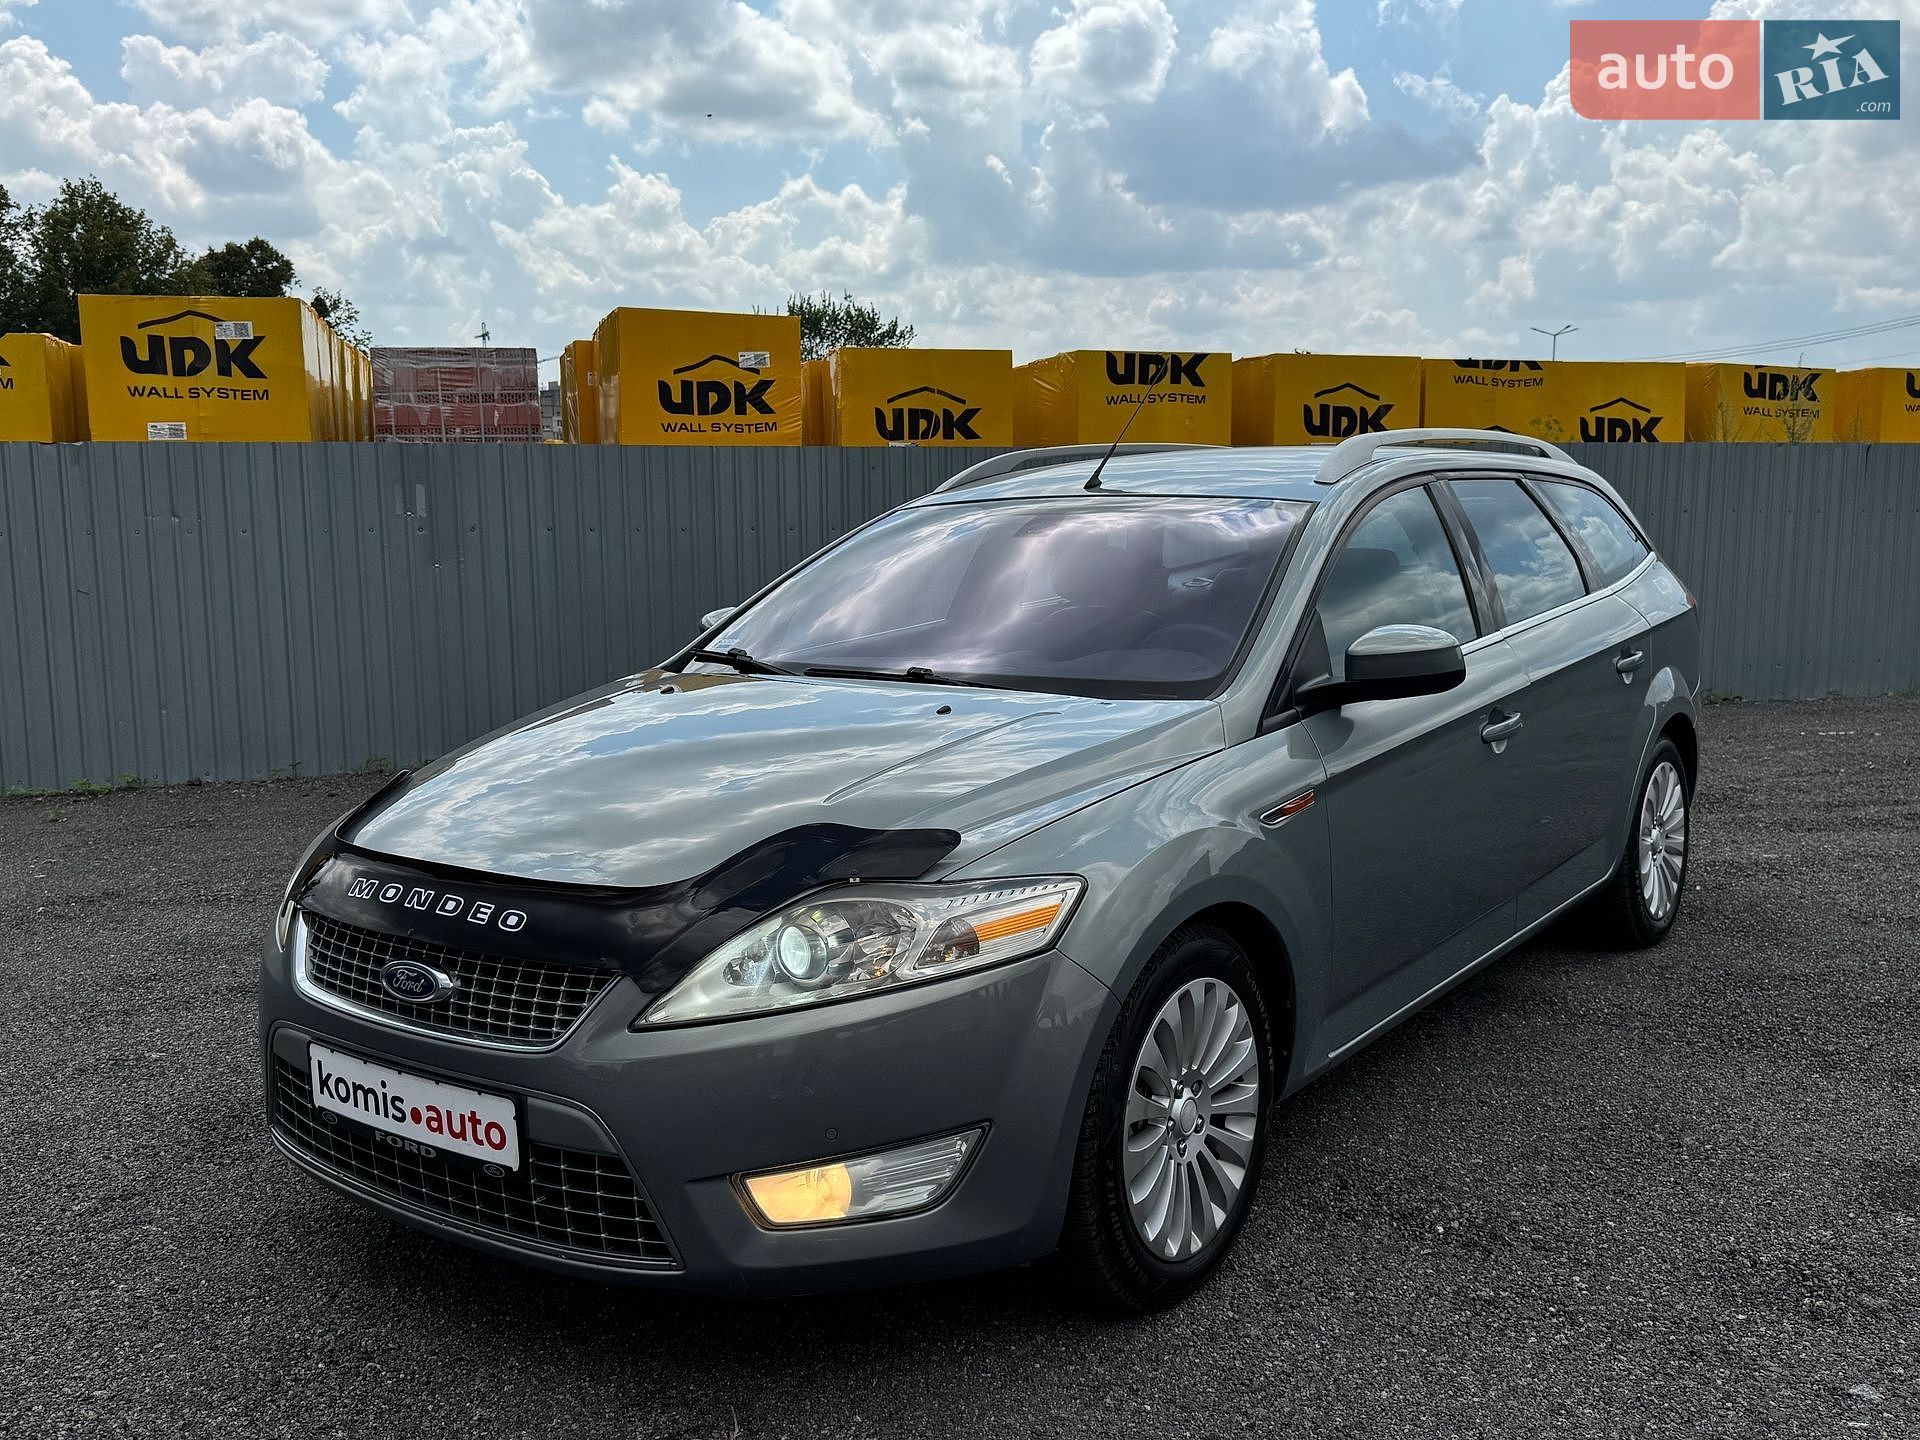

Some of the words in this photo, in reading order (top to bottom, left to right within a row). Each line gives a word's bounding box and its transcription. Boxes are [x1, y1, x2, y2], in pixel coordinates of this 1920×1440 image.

[119, 334, 268, 379] UDK
[1105, 351, 1210, 388] UDK
[127, 385, 184, 399] WALL
[188, 387, 270, 401] SYSTEM
[1453, 375, 1488, 386] WALL
[1491, 377, 1544, 388] SYSTEM
[1743, 371, 1822, 402] UDK
[657, 379, 777, 416] UDK
[1106, 393, 1144, 405] WALL
[1147, 392, 1206, 405] SYSTEM
[874, 406, 983, 441] UDK
[1303, 403, 1395, 437] UDK
[1743, 406, 1773, 417] WALL
[1775, 407, 1820, 419] SYSTEM
[661, 422, 707, 433] WALL
[711, 421, 777, 434] SYSTEM
[1579, 416, 1664, 442] UDK
[348, 877, 527, 932] MONDEO
[393, 969, 425, 993] Ford
[374, 1130, 437, 1159] FORD
